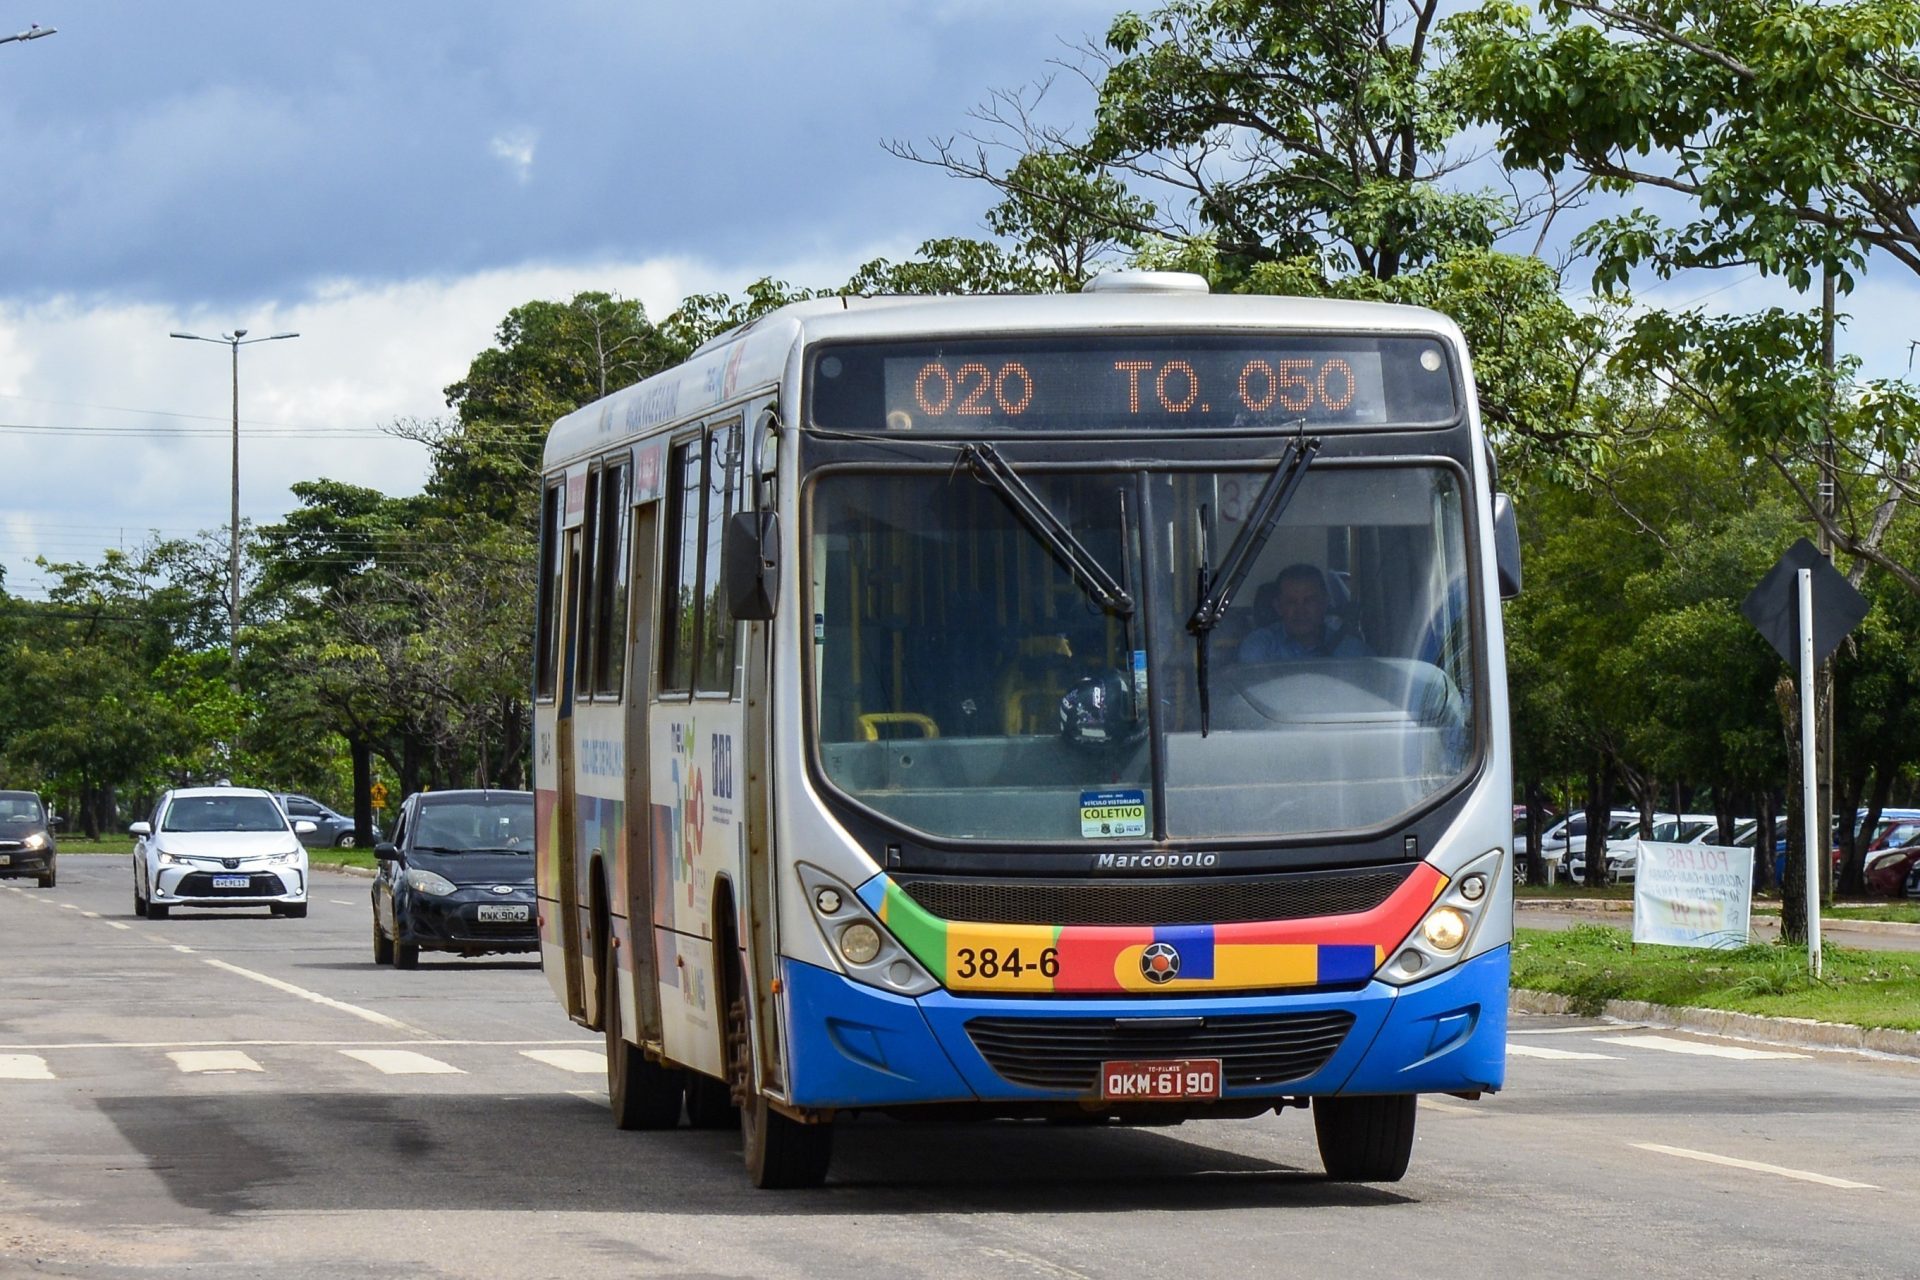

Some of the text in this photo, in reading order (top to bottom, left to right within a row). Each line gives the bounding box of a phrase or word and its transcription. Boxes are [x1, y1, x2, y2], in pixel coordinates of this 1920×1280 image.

[914, 358, 1355, 416] 020 TO. 050
[1083, 807, 1142, 819] COLETIVO
[1097, 852, 1215, 868] Marcopolo
[956, 947, 1060, 979] 384-6
[1108, 1072, 1214, 1095] QKM-6190
